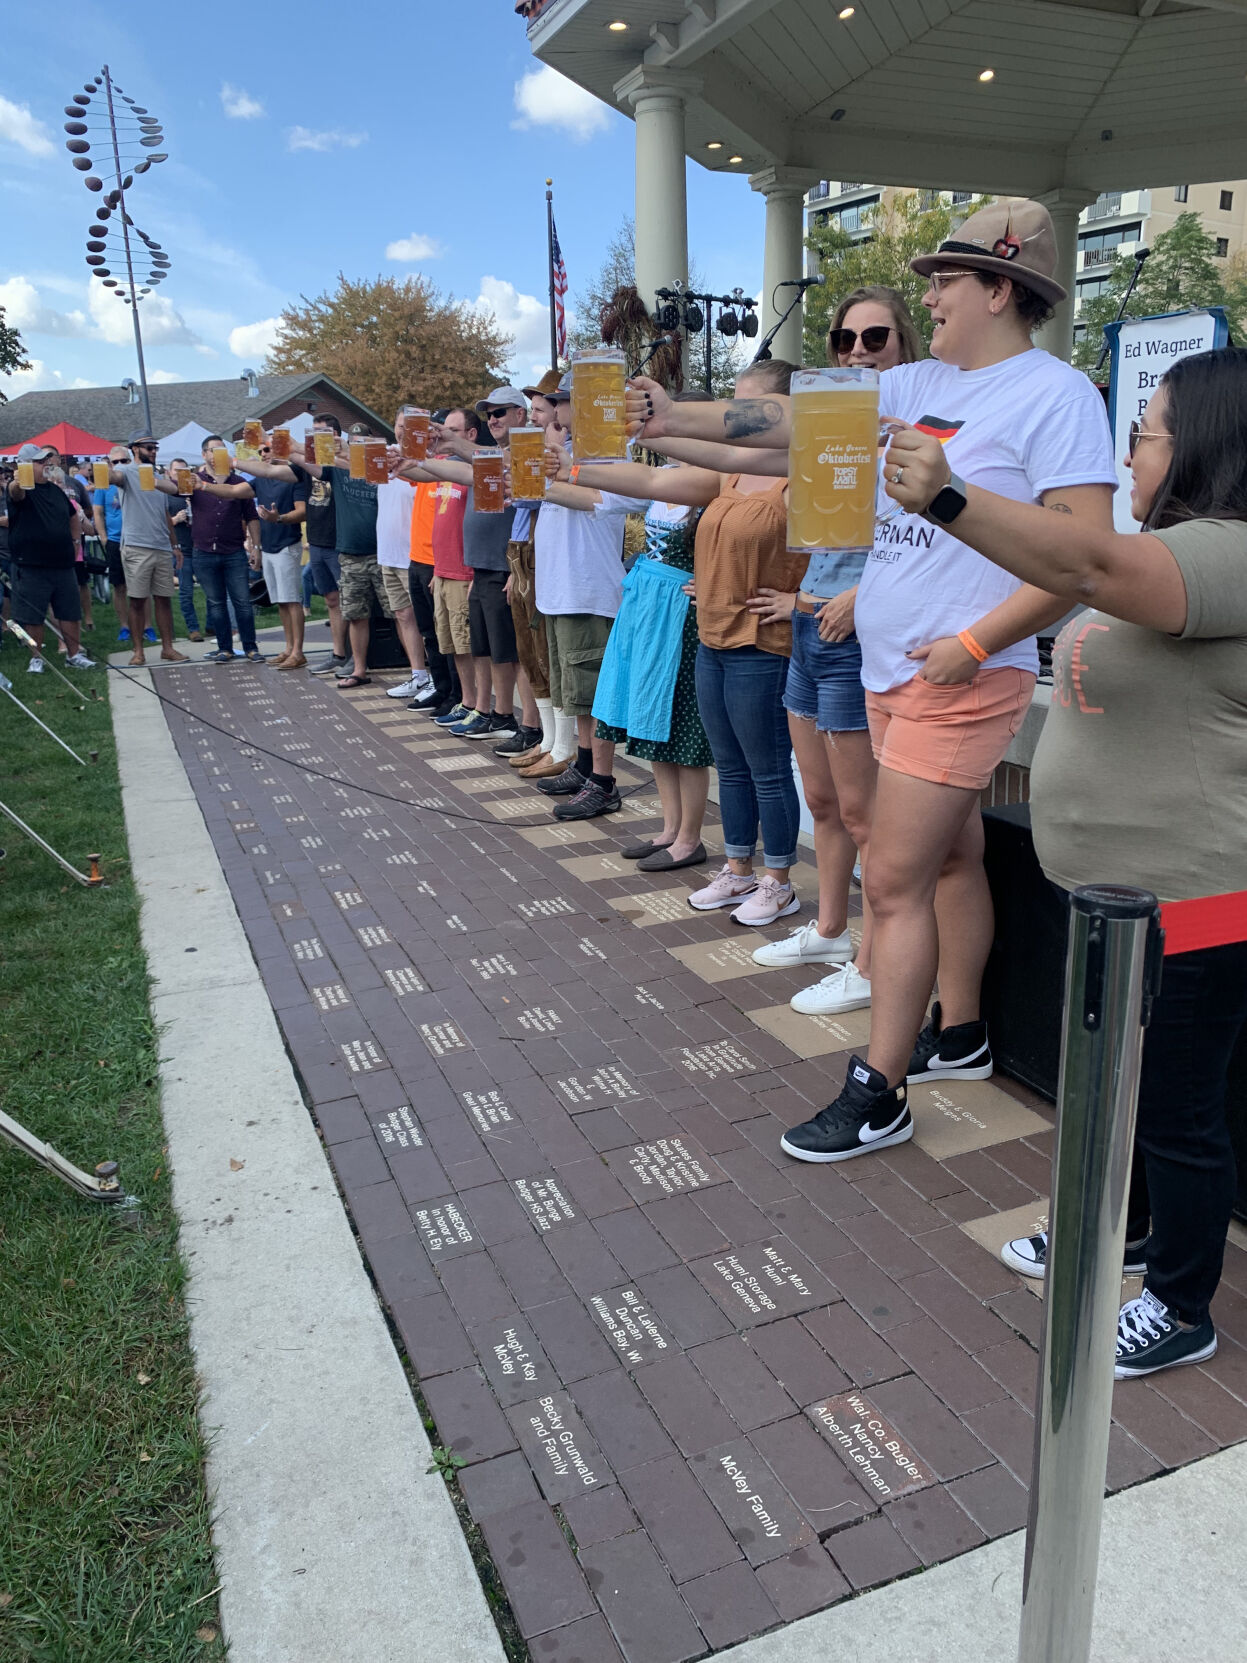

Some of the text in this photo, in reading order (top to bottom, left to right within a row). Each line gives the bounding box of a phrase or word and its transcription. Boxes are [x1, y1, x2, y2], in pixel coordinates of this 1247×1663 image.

[1125, 337, 1204, 359] Ed Wagner
[680, 1047, 708, 1071] Foundation
[695, 1051, 721, 1072] Lake Arts
[701, 1045, 734, 1073] From Geneva
[718, 1049, 743, 1070] Gratitude
[725, 1046, 742, 1058] Carol
[557, 1080, 580, 1103] Jacobson
[568, 1076, 587, 1095] Gordon
[596, 1068, 610, 1080] John
[612, 1071, 632, 1090] Memory
[398, 1106, 414, 1128] Stephan
[462, 1091, 491, 1132] Great Memories
[477, 1094, 487, 1105] Jen
[486, 1108, 500, 1124] Brian
[487, 1090, 499, 1102] Bob
[498, 1105, 514, 1121] Carol
[962, 1111, 987, 1129] Gloria
[381, 1128, 396, 1143] 2016
[387, 1111, 409, 1147] Badger Class
[633, 1165, 653, 1185] Brody
[634, 1146, 674, 1193] Carly, Madison
[646, 1144, 685, 1189] Jordan, Taylor,
[656, 1139, 674, 1157] Doug
[674, 1161, 700, 1187] Kristine
[670, 1138, 710, 1182] Skates Family
[515, 1179, 551, 1230] Badger HS Jazz
[531, 1181, 561, 1222] of Mr. Bunge
[544, 1179, 575, 1218] Appreciation
[416, 1210, 432, 1230] Betty
[430, 1238, 443, 1250] Ely
[435, 1215, 452, 1236] honor
[445, 1235, 459, 1245] of
[444, 1203, 472, 1243] HABECKER
[712, 1260, 762, 1314] Lake Geneva
[725, 1255, 777, 1310] Huml Storage
[761, 1264, 787, 1286] Huml
[762, 1247, 812, 1296] Matt & Mary
[590, 1295, 643, 1363] Williams Bay, Wi
[615, 1307, 643, 1341] Duncan
[621, 1290, 668, 1350] Bill & LaVerne
[493, 1344, 516, 1376] McVey
[503, 1328, 538, 1382] Hugh & Kay
[530, 1416, 569, 1476] and Family
[539, 1396, 598, 1486] Becky Grunwald
[814, 1407, 891, 1495] Alberth Lehman
[850, 1423, 885, 1459] Nancy
[885, 1441, 923, 1480] Bugler
[719, 1455, 782, 1538] McVey Family
